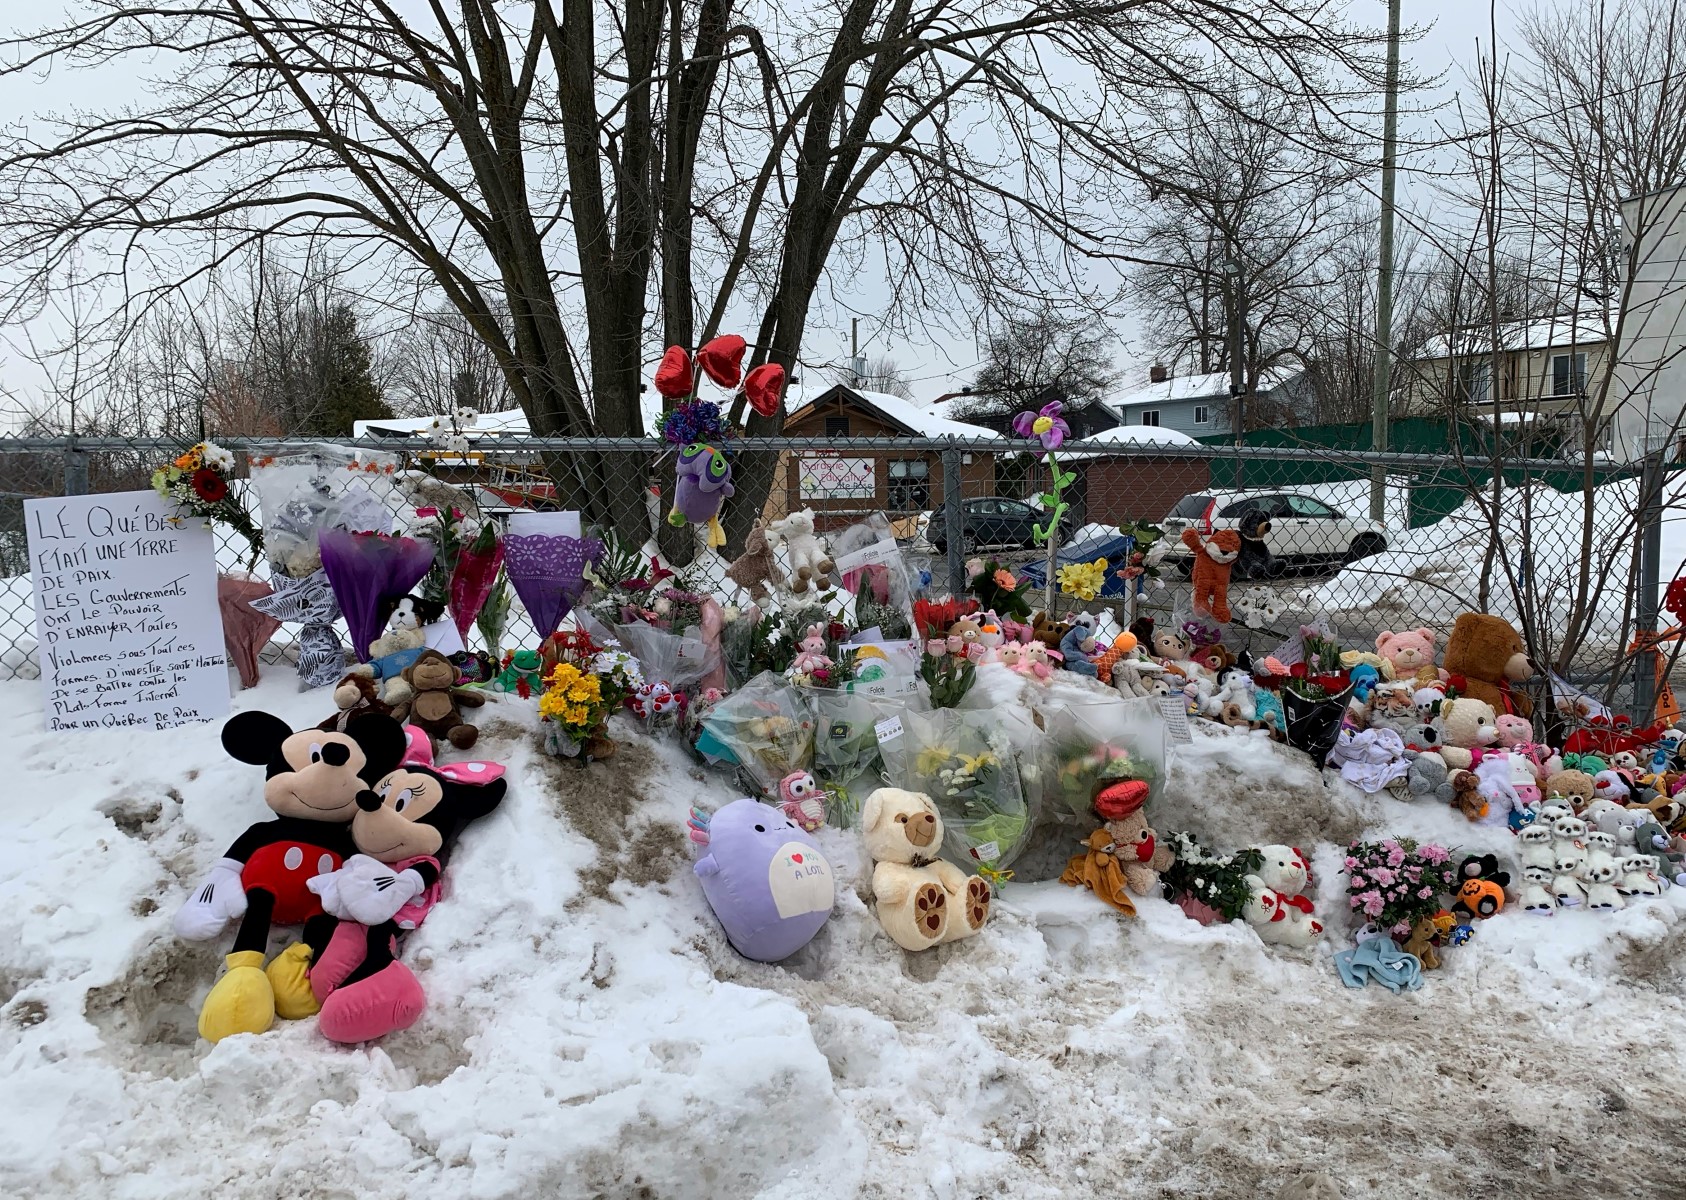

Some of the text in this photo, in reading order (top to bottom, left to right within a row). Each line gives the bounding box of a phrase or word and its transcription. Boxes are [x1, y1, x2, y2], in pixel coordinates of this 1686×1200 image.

[36, 505, 76, 539] LE
[95, 541, 126, 560] UNE
[130, 537, 179, 556] TERRE
[39, 575, 65, 592] DE
[41, 592, 80, 611] LES
[177, 643, 195, 652] ces
[50, 689, 70, 700] De
[75, 687, 88, 696] se
[173, 673, 187, 682] les
[82, 720, 99, 729] un
[154, 712, 168, 722] De
[173, 707, 198, 718] Paix
[784, 852, 819, 866] I YOU
[795, 870, 803, 880] A
